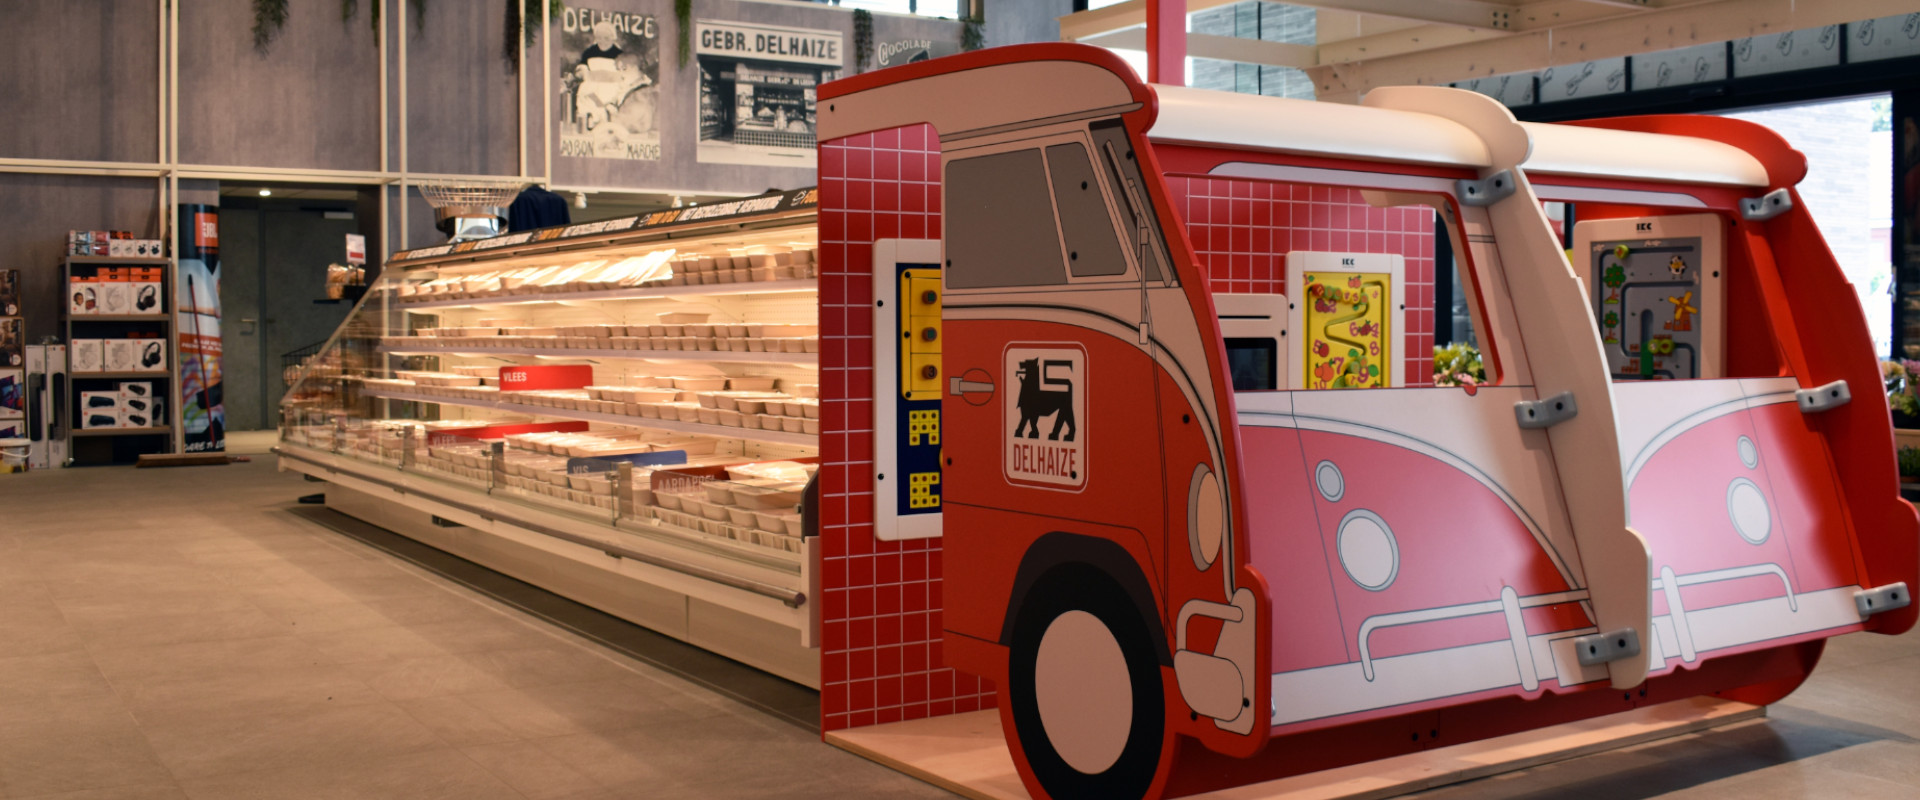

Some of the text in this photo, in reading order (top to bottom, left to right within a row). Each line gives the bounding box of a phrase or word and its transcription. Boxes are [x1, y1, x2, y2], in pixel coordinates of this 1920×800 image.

[563, 7, 655, 38] DELHAIZE
[702, 29, 837, 59] GEBR. DELHAIZE
[878, 40, 931, 66] CHOCOLADE
[574, 140, 594, 156] BON
[1349, 321, 1360, 337] 6
[1369, 340, 1380, 356] 8
[928, 364, 935, 379] 3
[1334, 357, 1345, 375] 7
[503, 371, 527, 382] VLEES
[1357, 366, 1369, 383] 9
[1013, 443, 1077, 478] DELHAIZE
[573, 464, 589, 475] VIS
